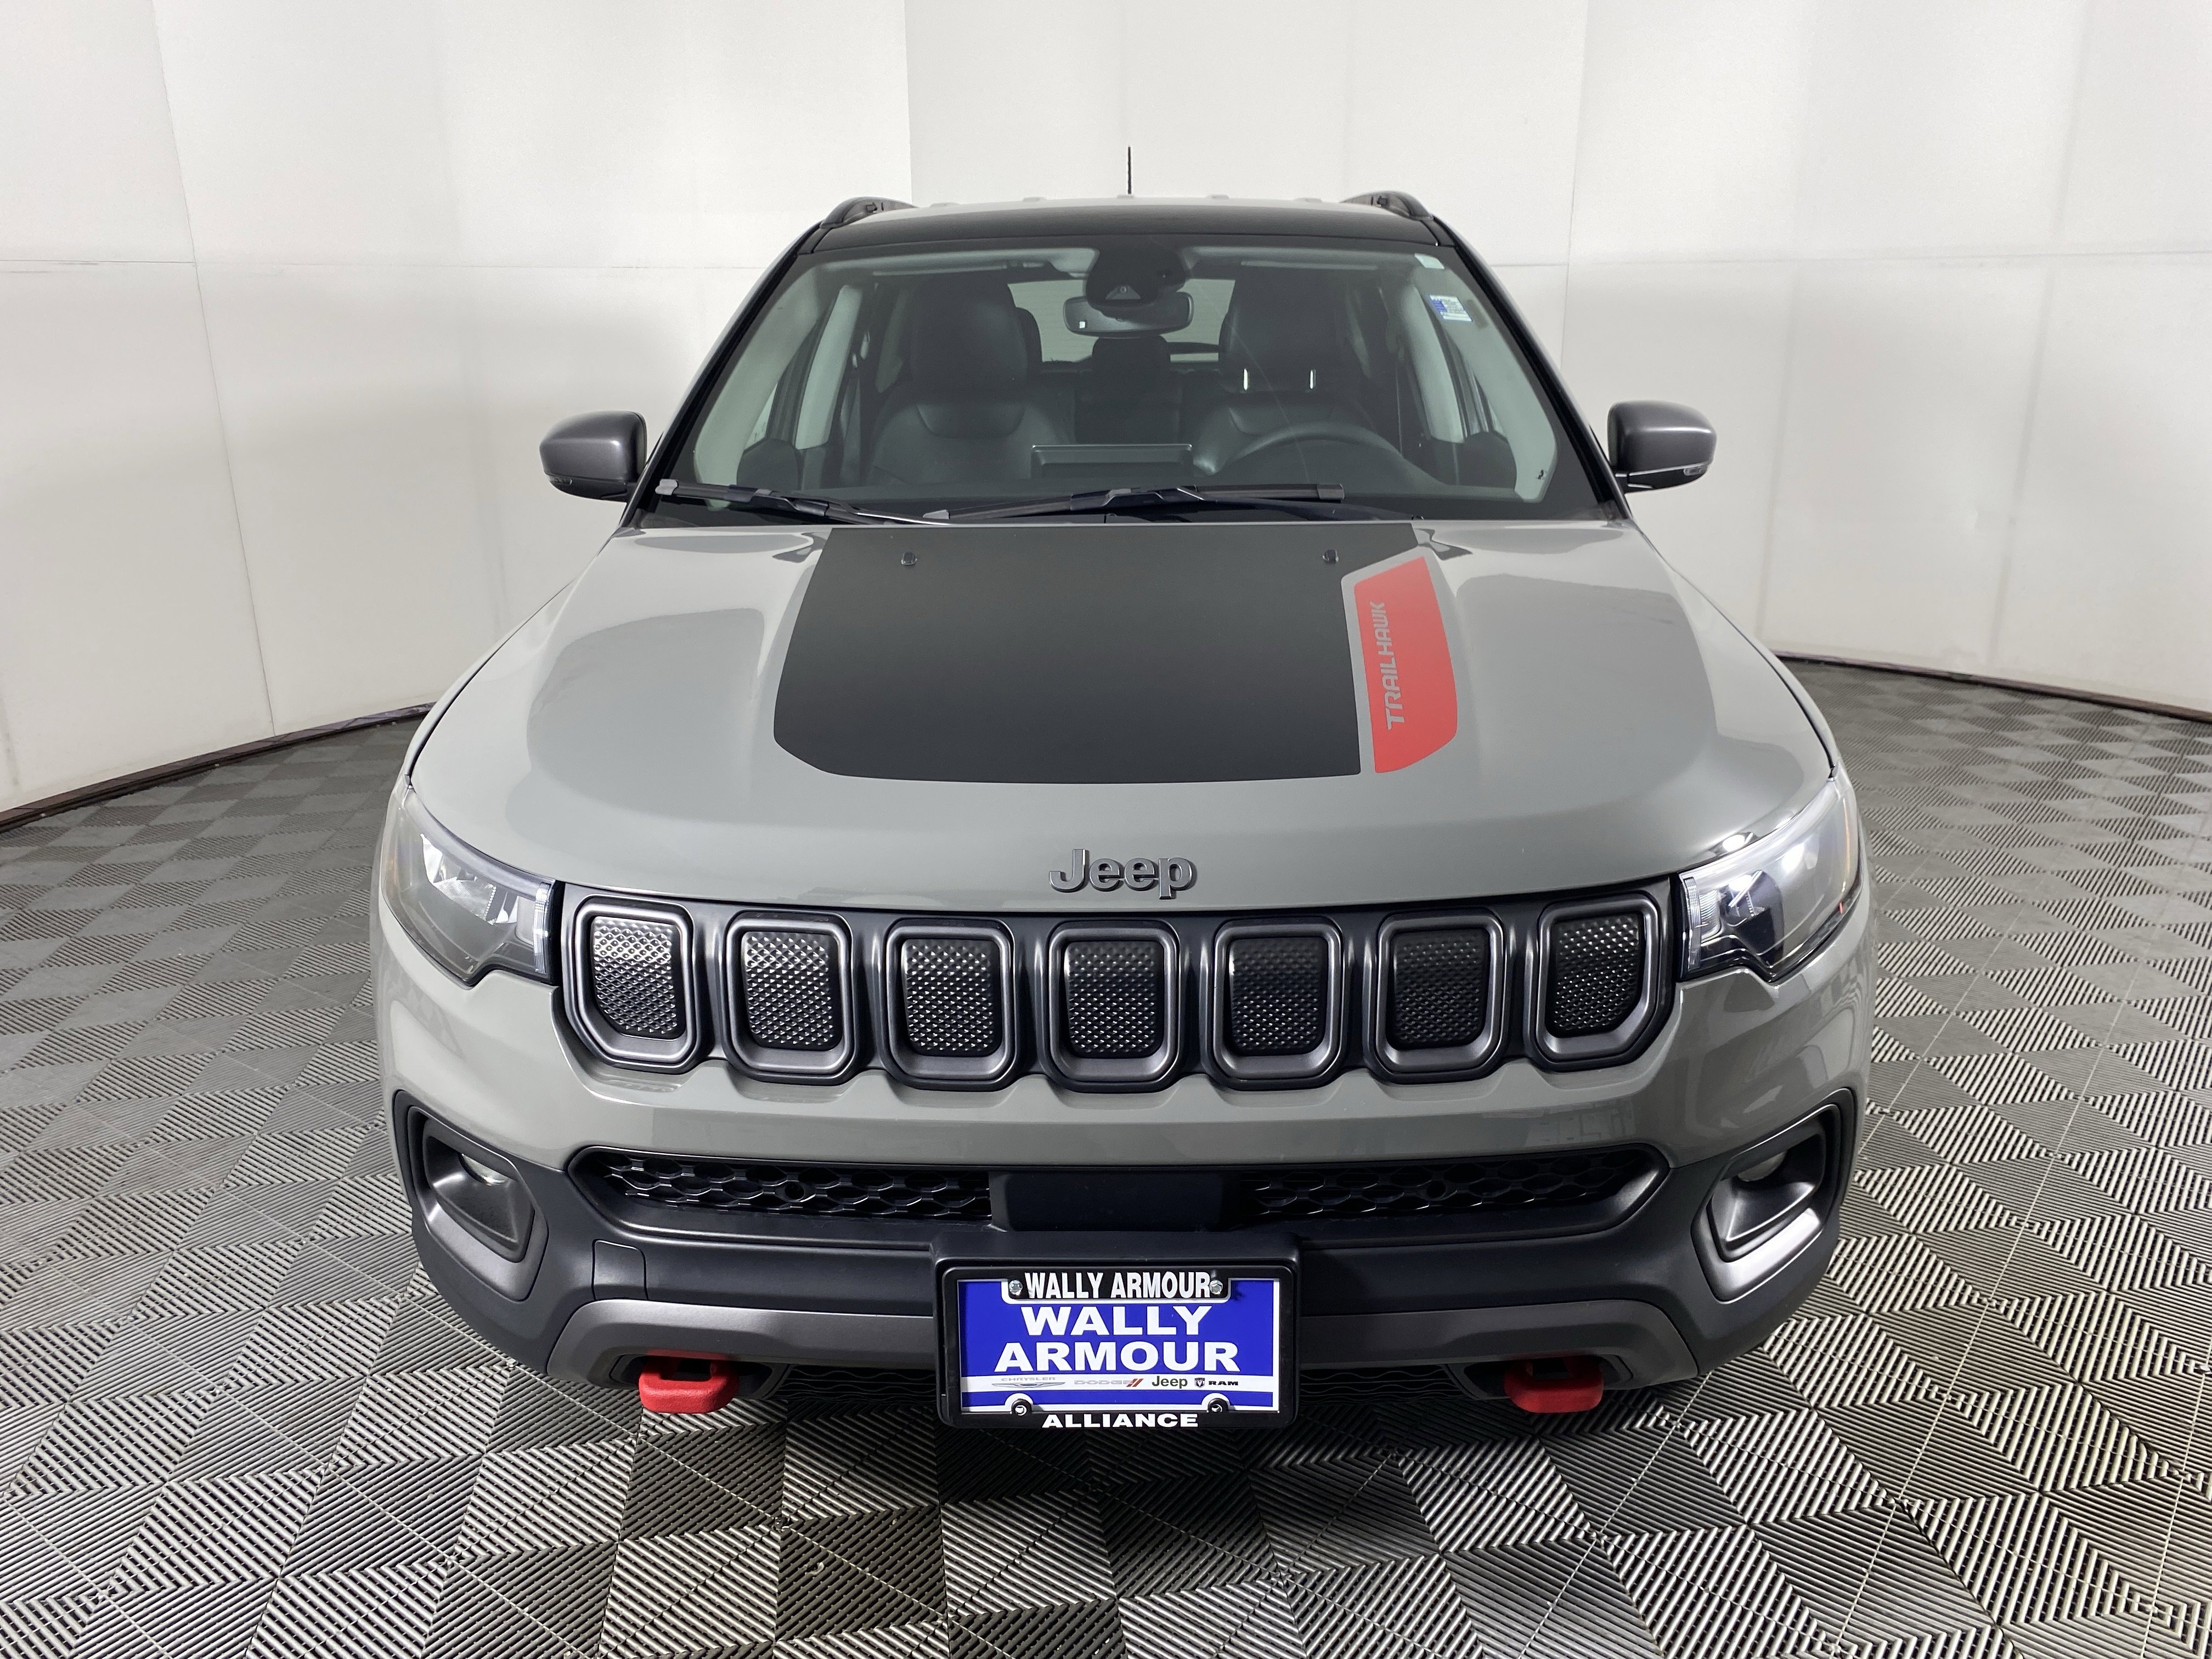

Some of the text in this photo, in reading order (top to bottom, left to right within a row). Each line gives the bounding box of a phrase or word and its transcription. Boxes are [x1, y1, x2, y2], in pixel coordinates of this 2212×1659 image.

[1370, 601, 1405, 730] TRAILHAWK
[1049, 848, 1196, 899] Jeep
[1024, 1272, 1210, 1299] WALLY ARMOUR
[1021, 1306, 1212, 1335] WALLY
[994, 1341, 1240, 1372] ARMOUR
[1151, 1375, 1188, 1389] Jeep
[1042, 1413, 1198, 1428] ALLIANCE
